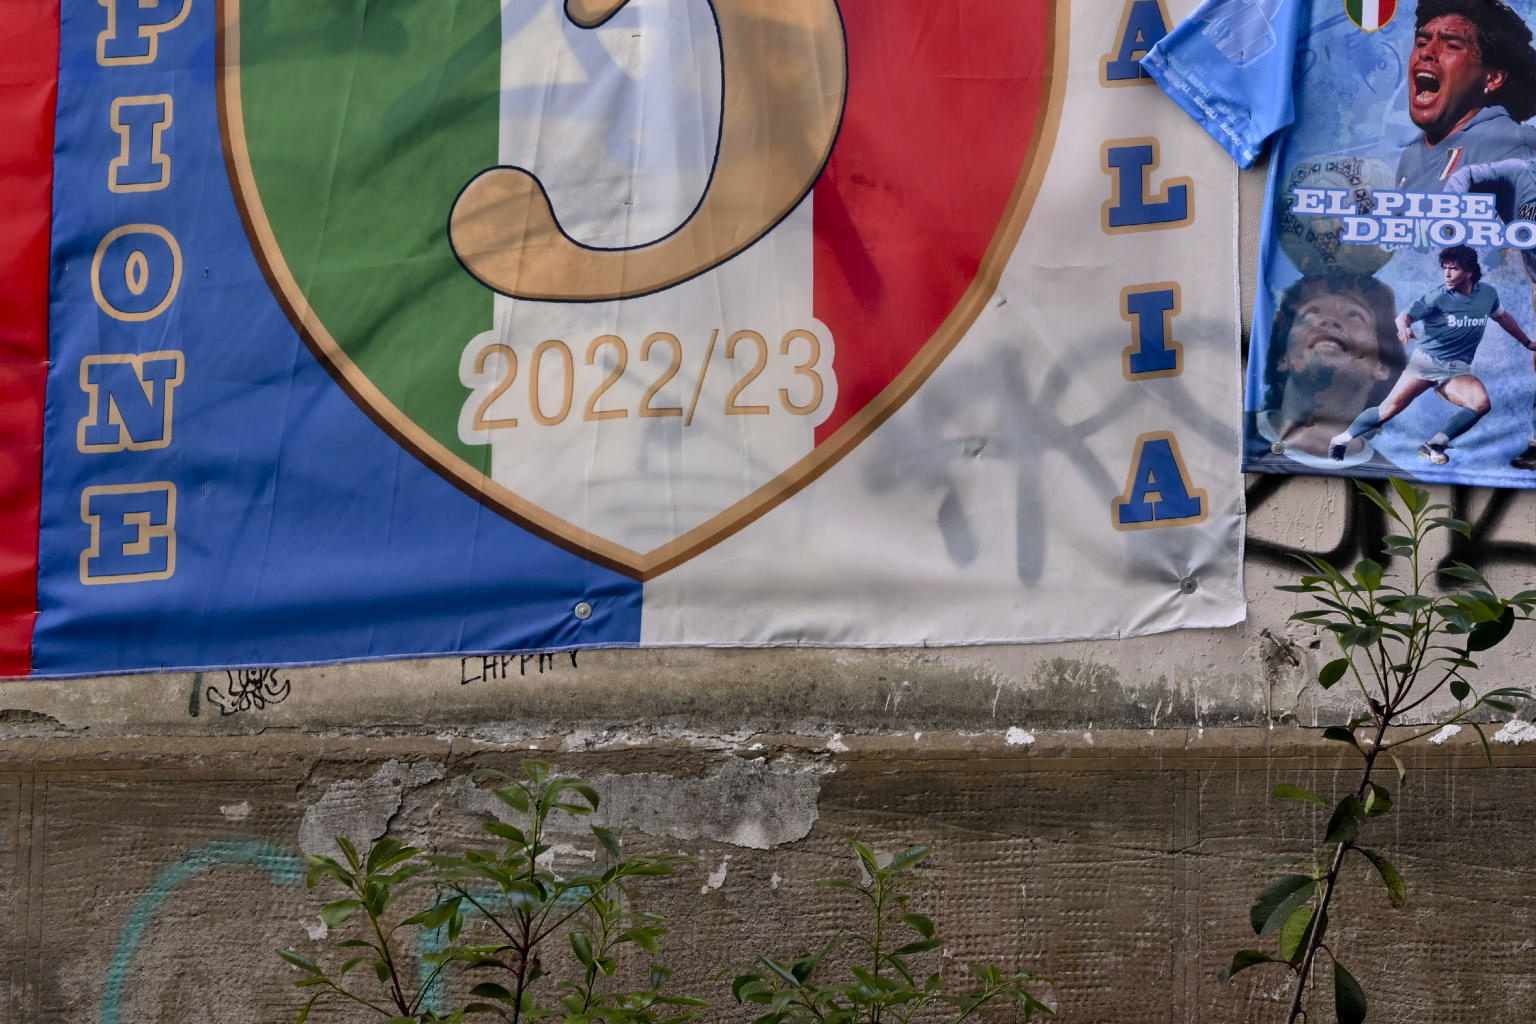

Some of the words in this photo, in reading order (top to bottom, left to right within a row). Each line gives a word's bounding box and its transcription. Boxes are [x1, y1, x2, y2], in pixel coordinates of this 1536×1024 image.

[1292, 188, 1356, 215] EL
[1372, 192, 1494, 219] PIBE
[1342, 216, 1412, 244] DE
[473, 328, 824, 431] 2022/23
